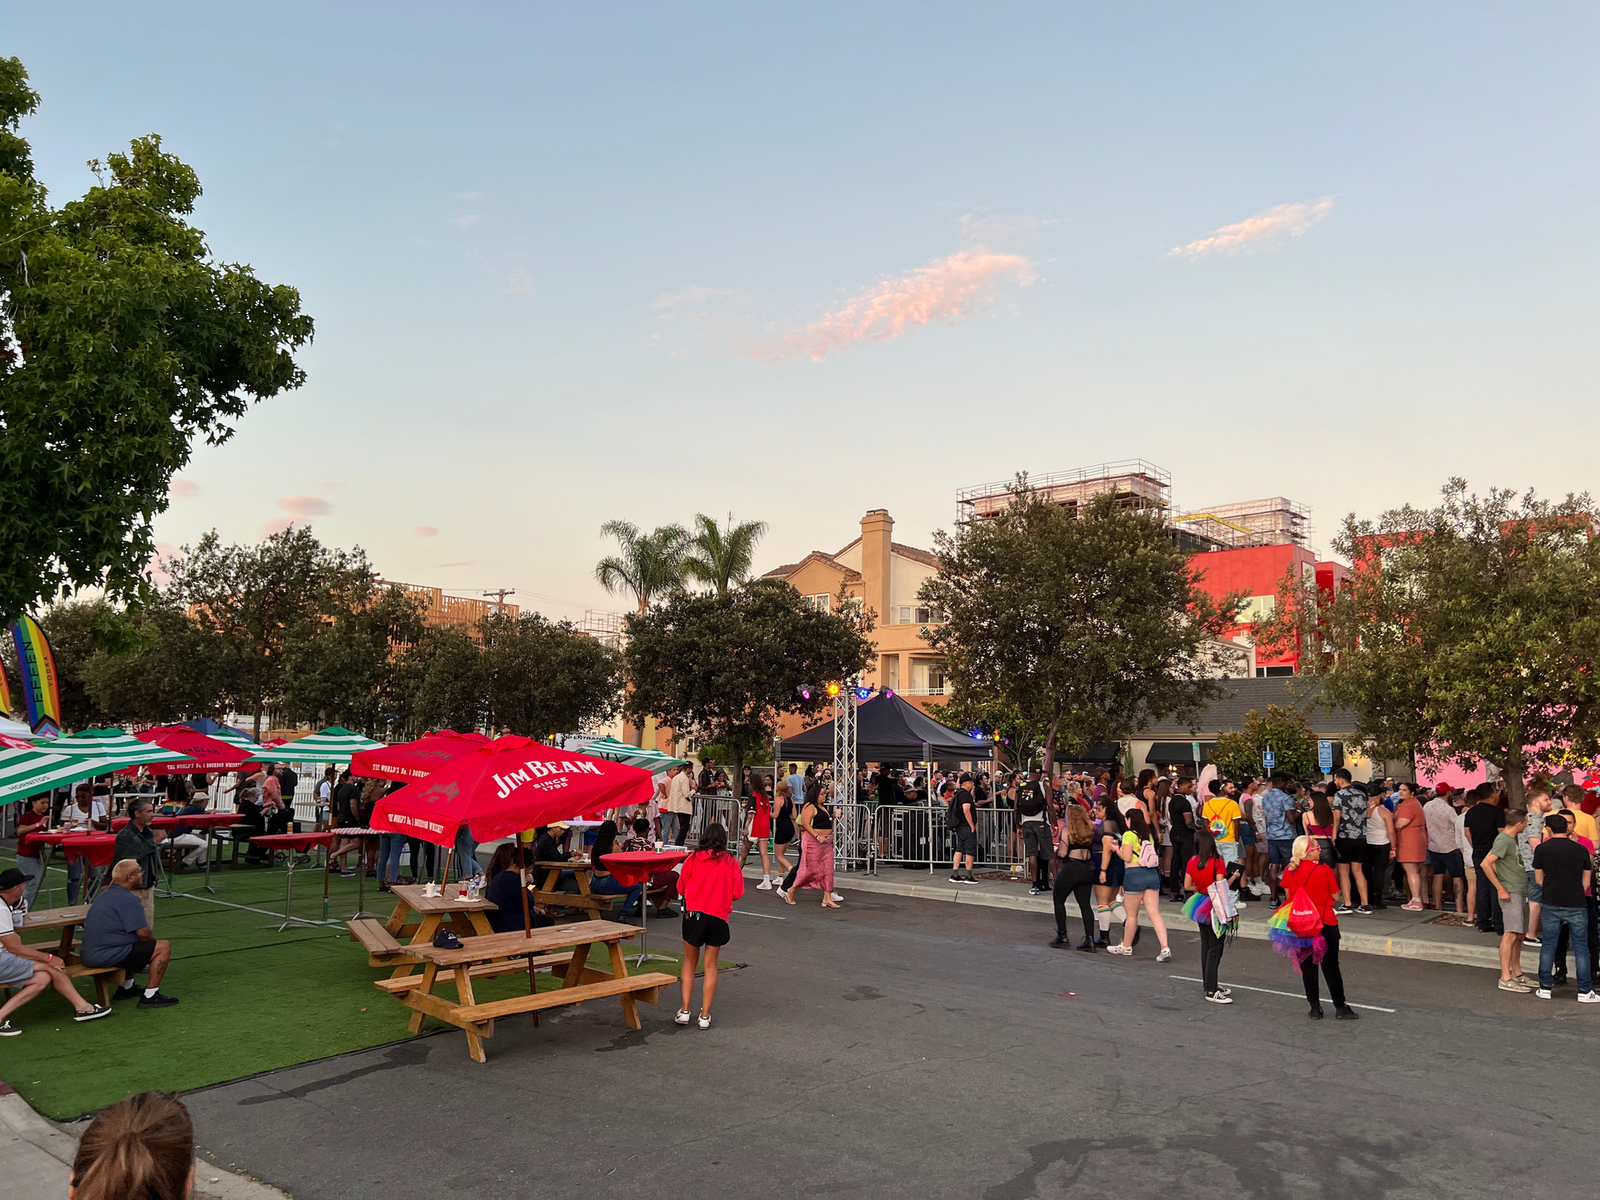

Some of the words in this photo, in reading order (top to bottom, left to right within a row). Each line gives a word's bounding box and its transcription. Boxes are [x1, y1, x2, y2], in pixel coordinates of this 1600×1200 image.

[22, 641, 43, 703] EFFEN
[44, 656, 53, 687] VODKA
[134, 722, 152, 733] STOP
[194, 746, 220, 756] BEAM
[381, 765, 400, 774] WORLD'S
[8, 776, 50, 791] HORNITOS
[492, 768, 532, 799] JIM
[524, 760, 604, 775] BEAM
[533, 776, 568, 789] SINCE
[542, 782, 568, 792] 1795
